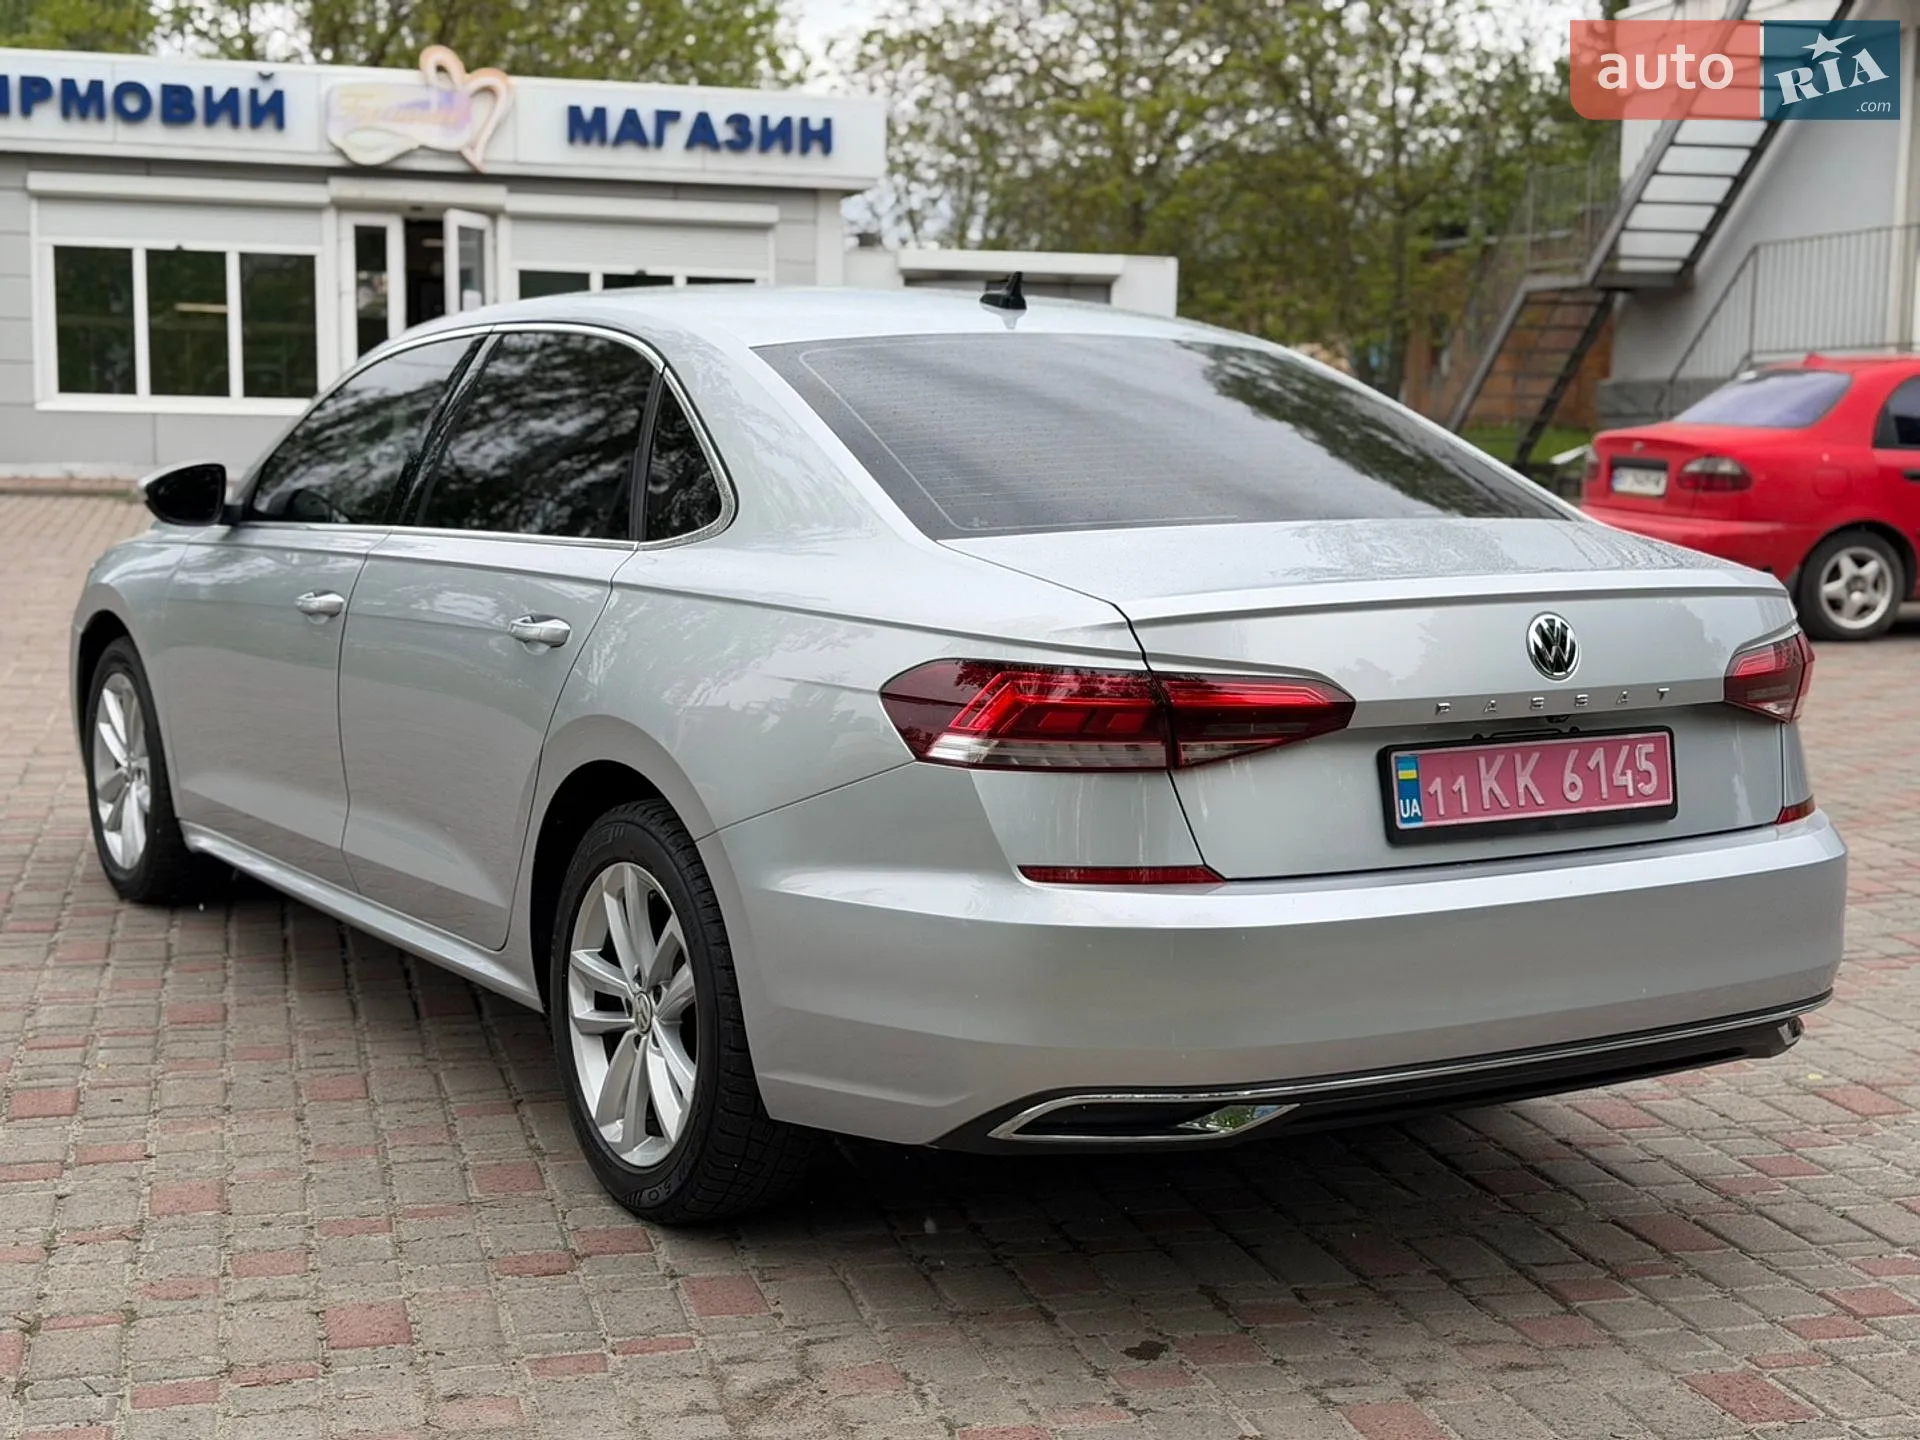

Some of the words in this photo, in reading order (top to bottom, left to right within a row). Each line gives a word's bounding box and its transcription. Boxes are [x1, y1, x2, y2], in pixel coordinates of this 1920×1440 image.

[567, 105, 832, 156] МАГАЗИН
[1562, 743, 1657, 803] 6145
[1400, 799, 1422, 818] UA
